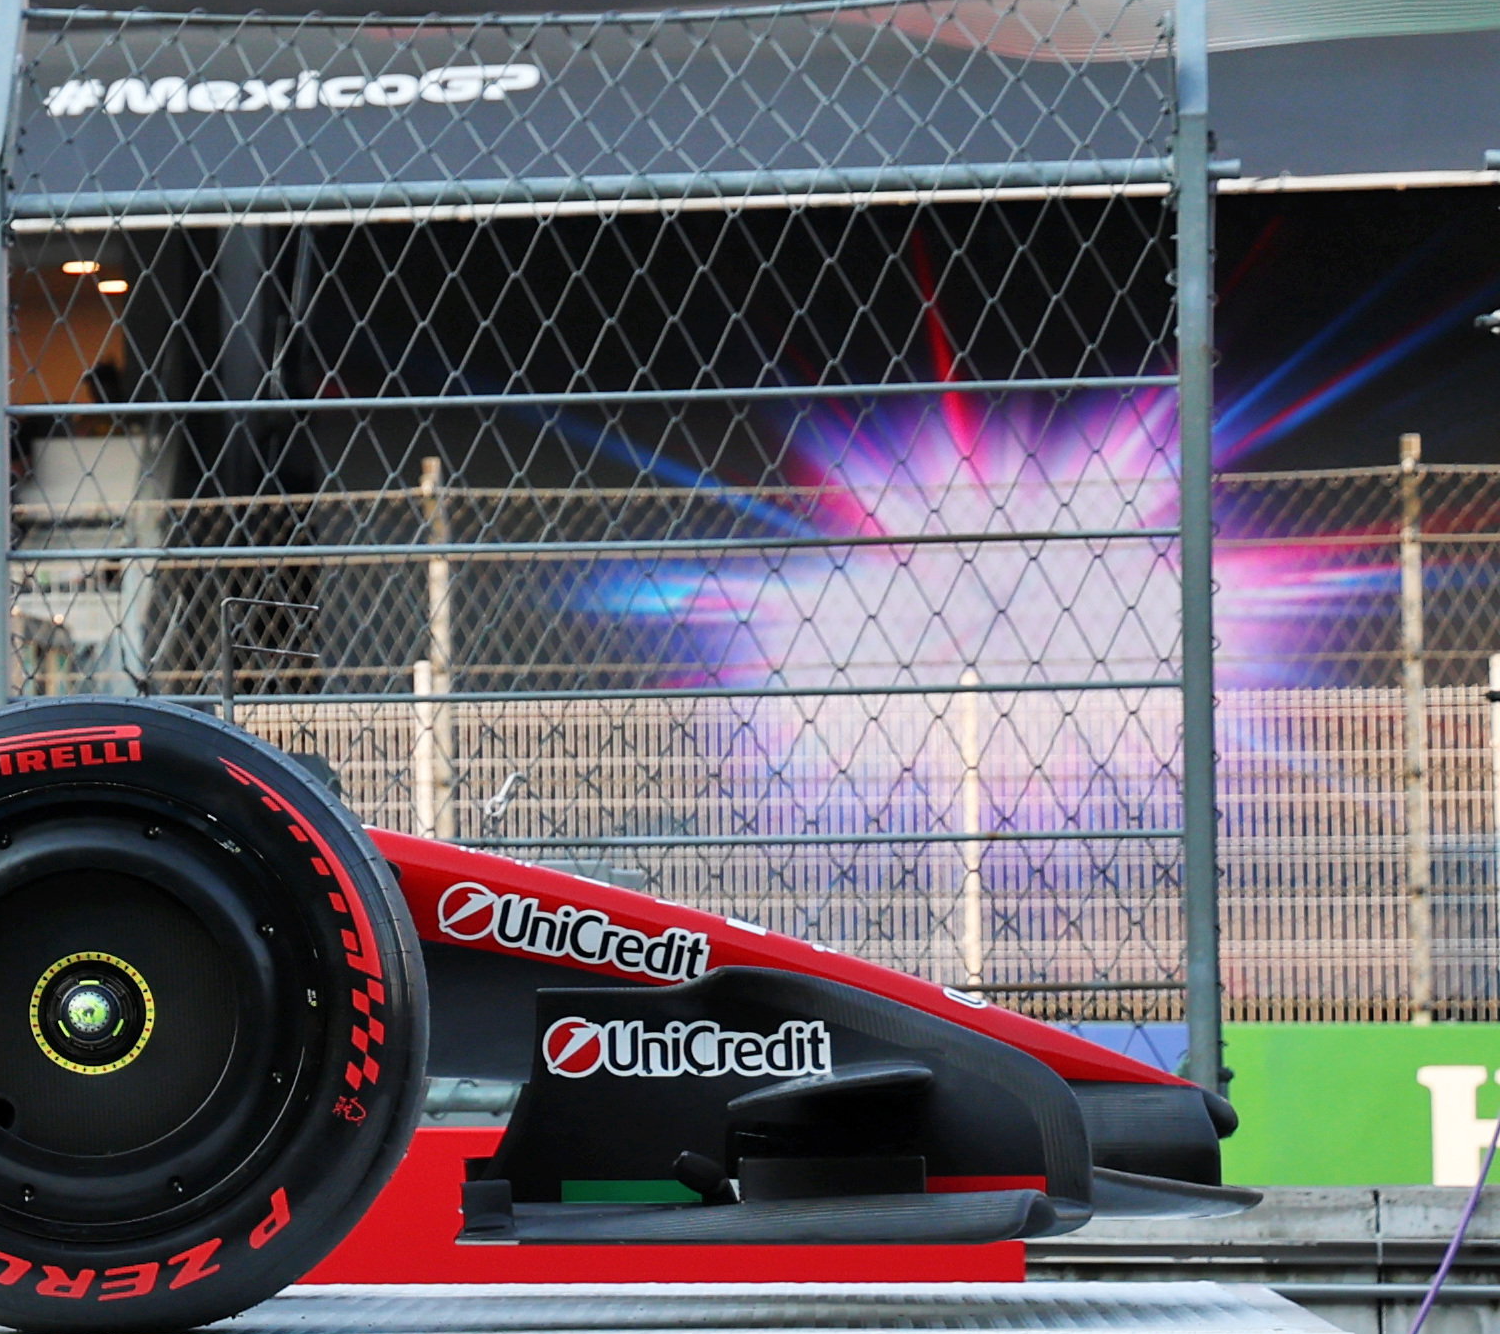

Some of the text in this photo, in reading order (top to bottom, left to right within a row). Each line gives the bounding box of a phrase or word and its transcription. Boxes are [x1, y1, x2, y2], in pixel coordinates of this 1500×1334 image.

[42, 63, 541, 117] #MexicoGP
[494, 896, 707, 981] UniCredit
[605, 1022, 828, 1076] UniCredit
